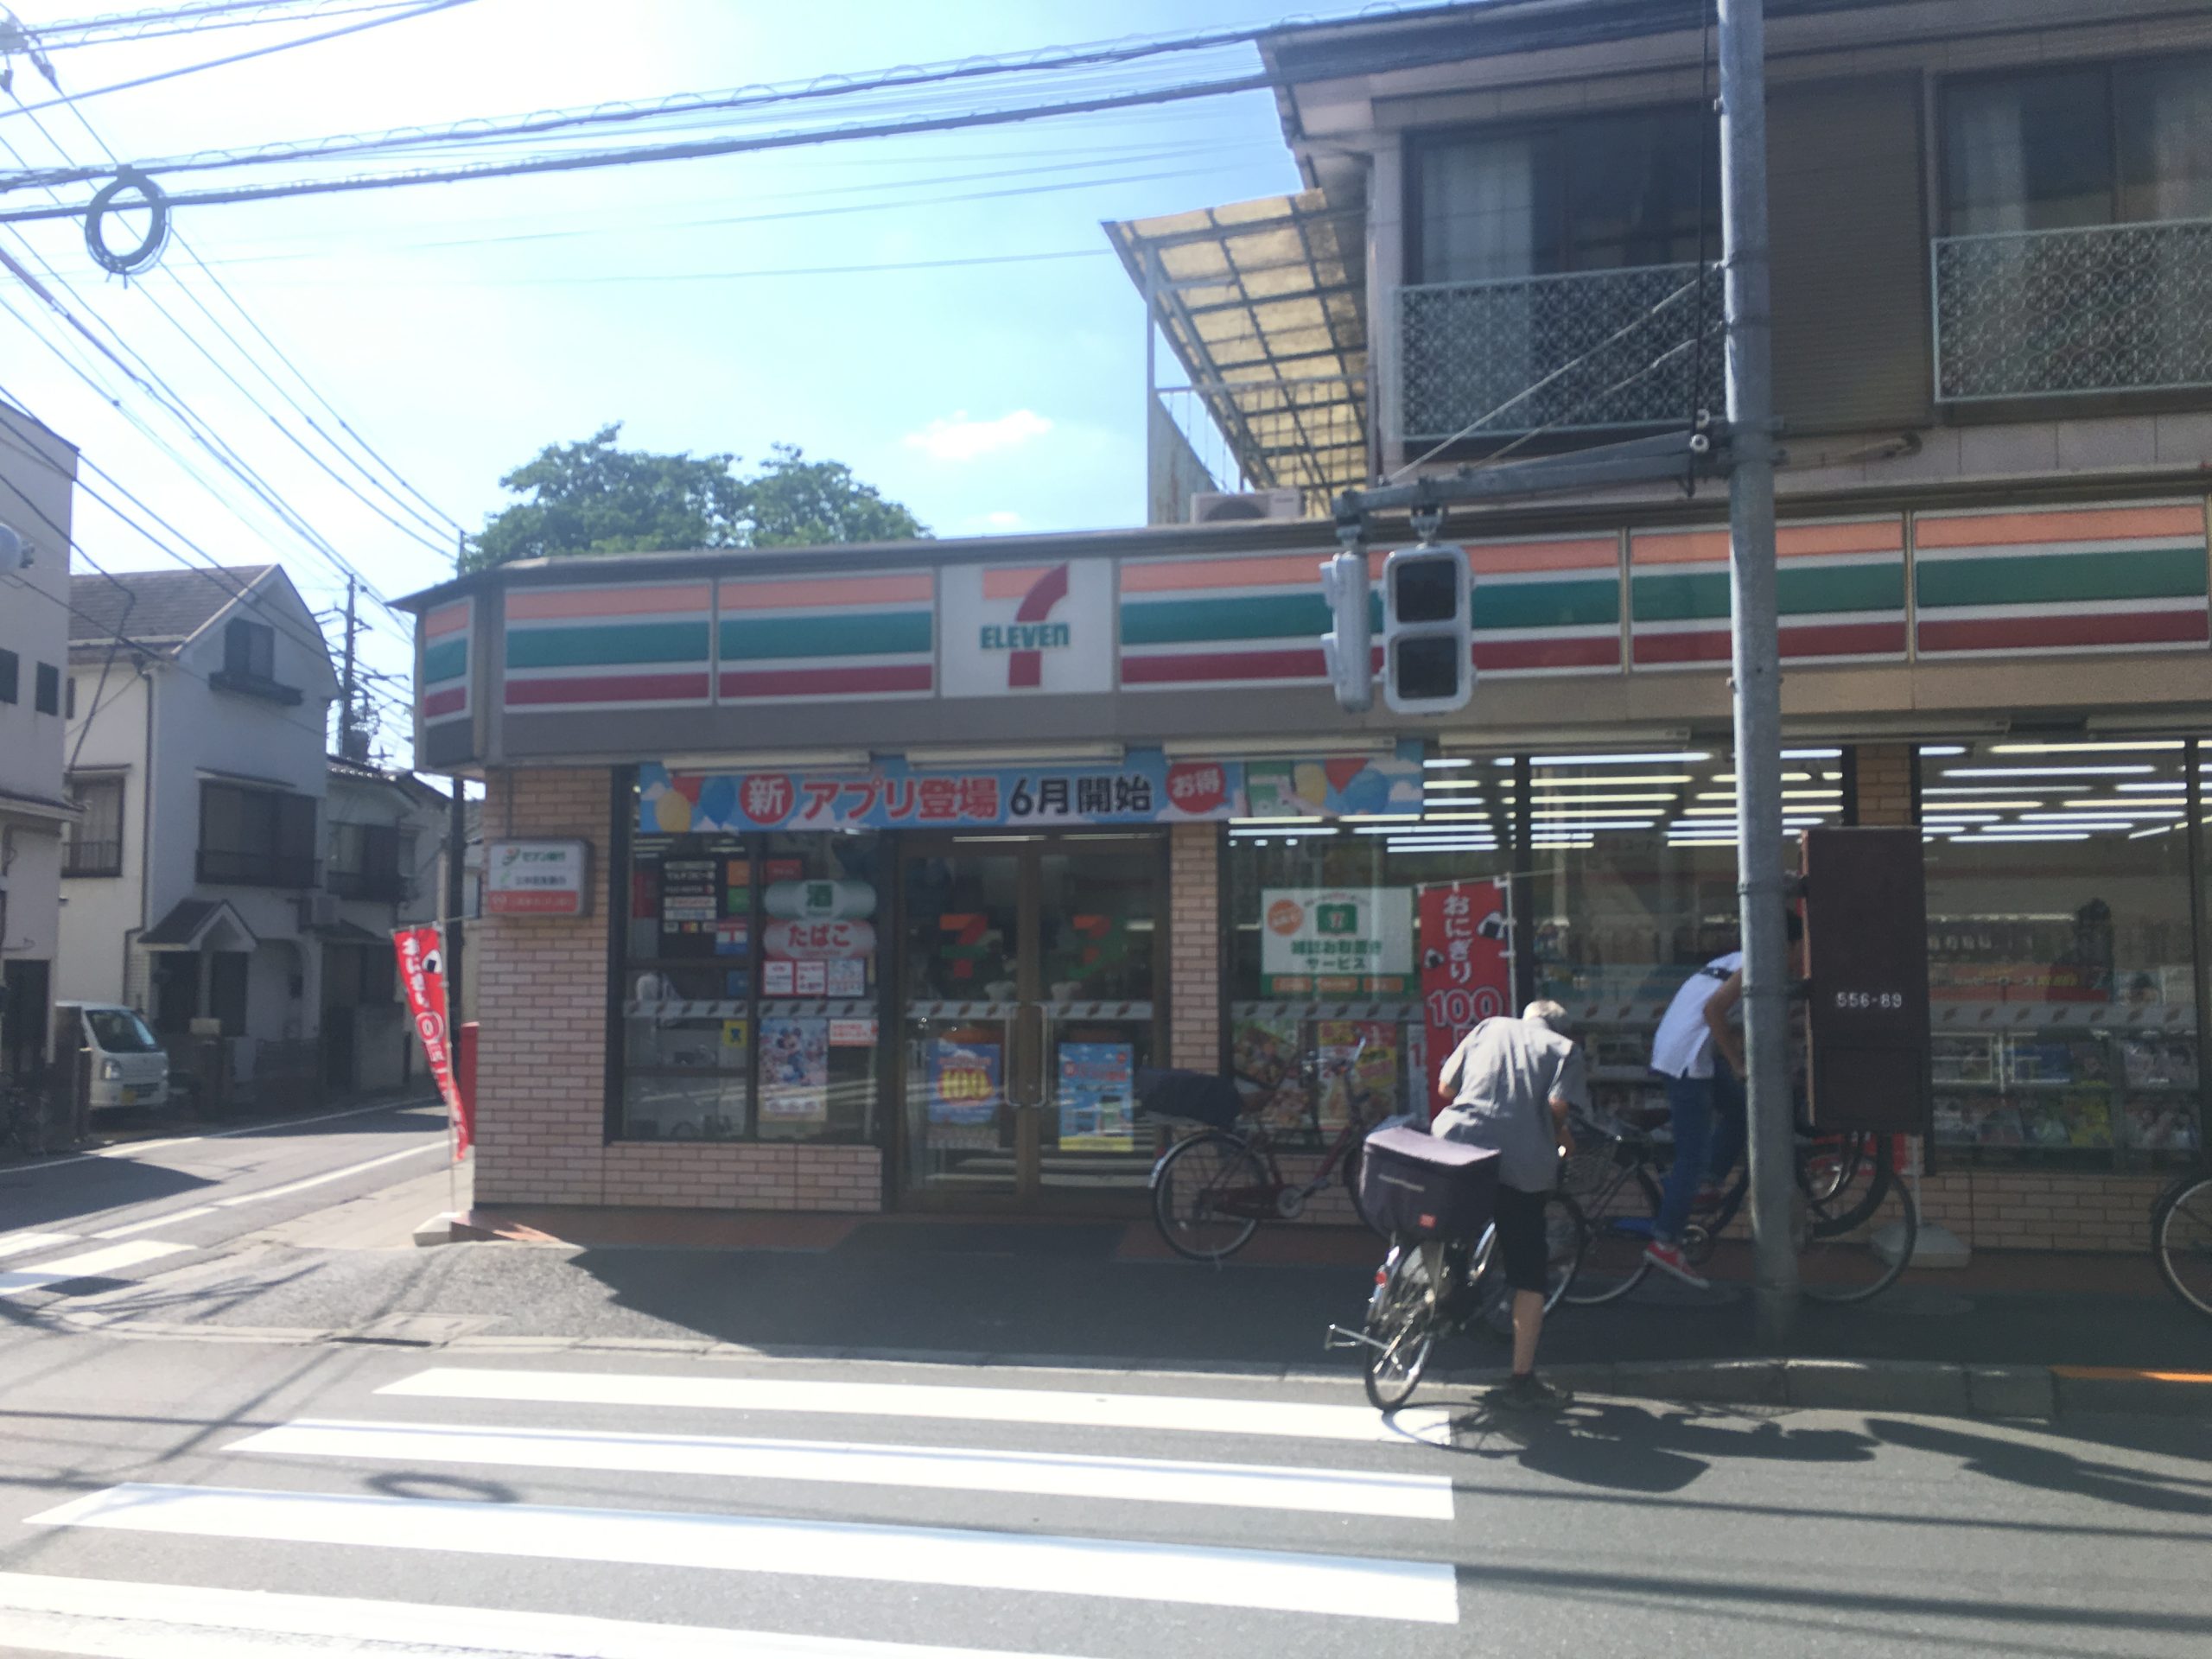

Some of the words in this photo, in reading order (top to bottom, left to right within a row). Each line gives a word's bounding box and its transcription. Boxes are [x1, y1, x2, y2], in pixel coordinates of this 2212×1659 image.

[982, 563, 1069, 688] 7
[747, 778, 785, 816] 新
[803, 776, 998, 819] アプリ登場
[1009, 773, 1152, 817] 6月開始
[788, 922, 851, 947] たばこ
[1443, 895, 1473, 984] おにぎり
[1426, 986, 1503, 1028] 100
[1836, 991, 1903, 1008] 556-89
